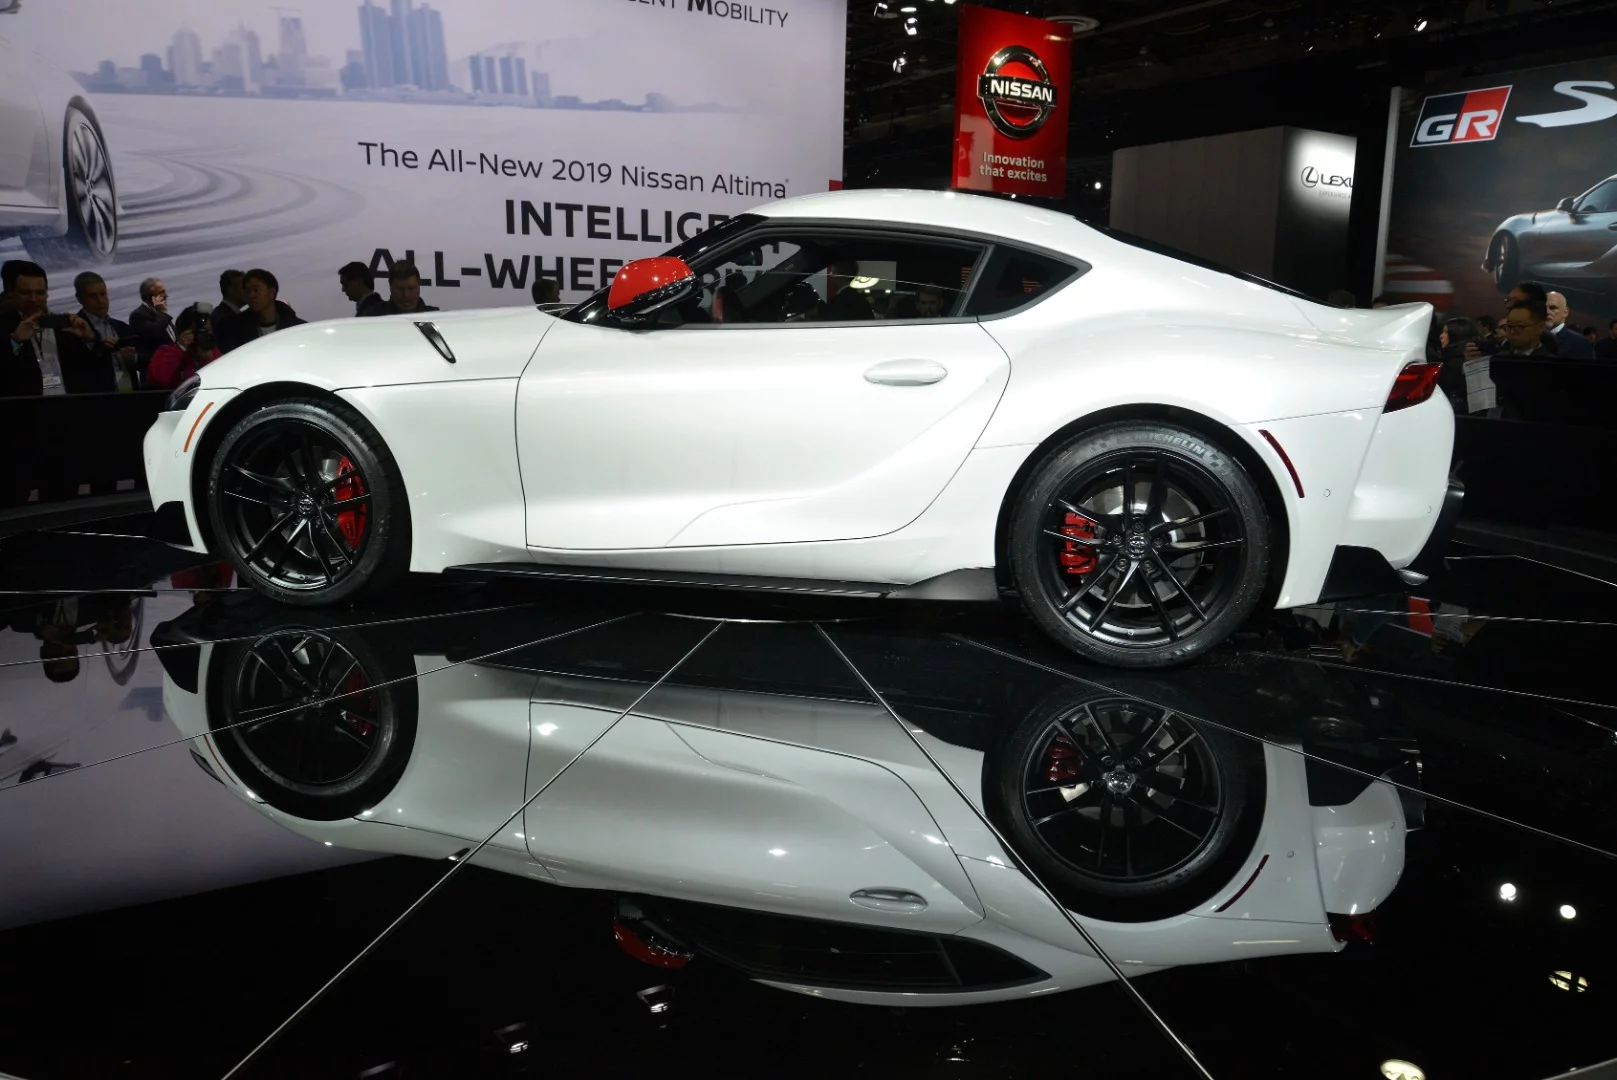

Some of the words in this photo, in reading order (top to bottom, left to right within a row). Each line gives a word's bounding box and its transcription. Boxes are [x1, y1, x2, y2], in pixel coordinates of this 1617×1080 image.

[687, 0, 789, 28] MOBILITY
[990, 79, 1053, 102] NISSAN
[1416, 109, 1499, 143] GR
[357, 141, 419, 169] The
[428, 148, 543, 178] All-New
[552, 158, 612, 184] 2019
[621, 164, 704, 192] Nissan
[711, 173, 787, 199] Altima
[979, 164, 1005, 178] that
[1007, 169, 1047, 182] excites
[983, 151, 1045, 169] Innovation
[1320, 173, 1354, 188] LEX
[505, 199, 732, 244] INTELLIG
[368, 248, 633, 291] AL-WHEE
[1134, 432, 1206, 457] MICHELIN
